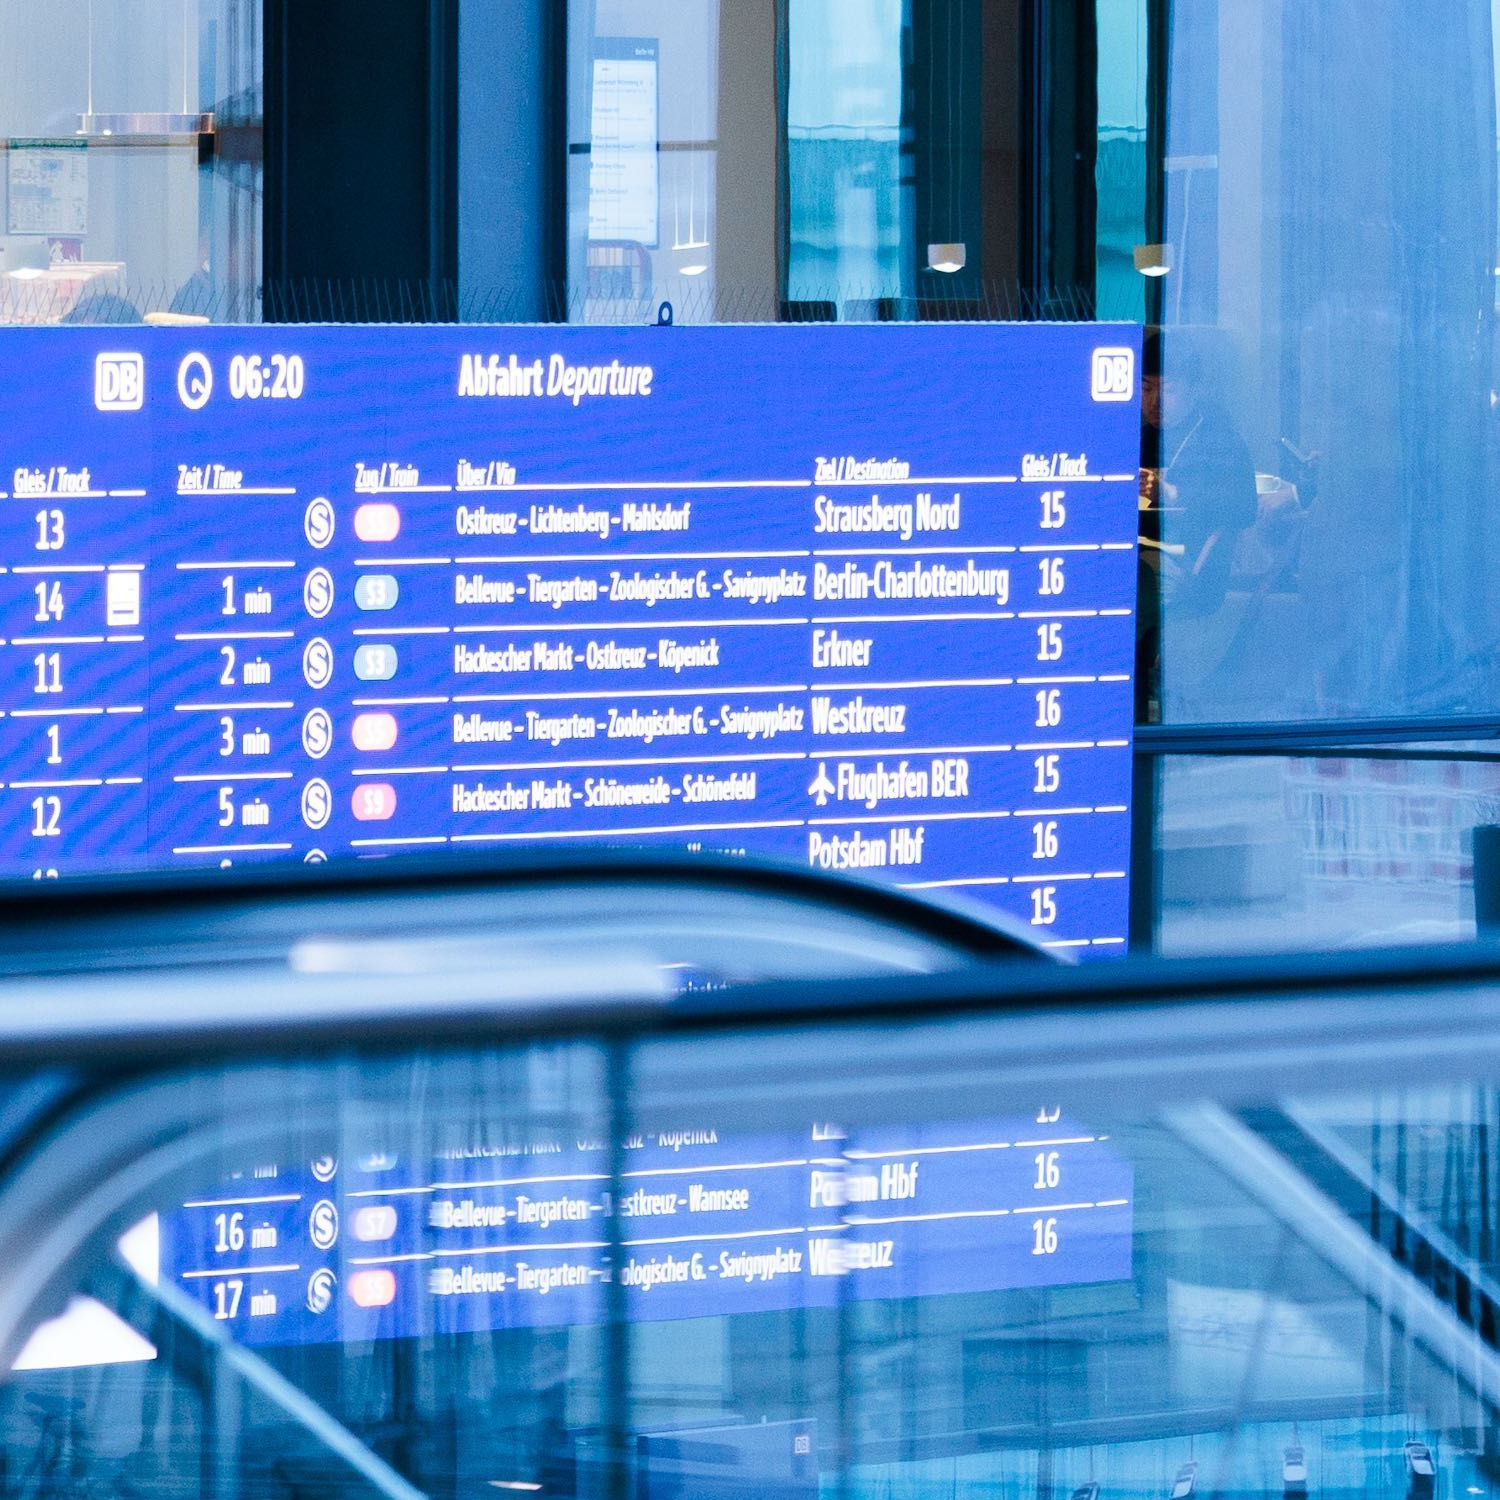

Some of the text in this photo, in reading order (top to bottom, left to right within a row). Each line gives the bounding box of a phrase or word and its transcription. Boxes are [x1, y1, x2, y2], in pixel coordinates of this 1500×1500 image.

[229, 353, 304, 399] 06:20
[457, 353, 654, 407] Abfahrt Departure
[35, 509, 65, 550] 13
[455, 501, 691, 540] Ostkreuz Lichtenberg Mahlsdorf
[814, 492, 961, 541] Strausberg Nord
[1039, 490, 1066, 529] 15
[221, 575, 272, 615] 1 min
[455, 569, 807, 610] Bellevue Tiergarten Zoologischer Savignyplatz
[813, 559, 1010, 606] Berlin-Charlottenburg
[1038, 557, 1065, 595] 16
[34, 580, 65, 622] 14
[454, 637, 720, 674] Hackescher Markt Ostkreuz Köpenick
[812, 629, 873, 668] Erkner
[1036, 622, 1063, 661] 15
[33, 652, 64, 694] 11
[220, 645, 271, 686] 2 min
[811, 695, 906, 735] Westkreuz
[1035, 688, 1061, 727] 16
[47, 724, 63, 764] 1
[219, 715, 271, 757] 3 min
[837, 758, 969, 810] Flughafen BER
[1033, 754, 1060, 793] 15
[31, 795, 61, 837] 12
[218, 786, 270, 827] 5 min
[808, 826, 925, 870] Potsdam Hbf
[1032, 820, 1059, 859] 16
[1030, 886, 1057, 926] 15
[1033, 1151, 1060, 1190] 16
[214, 1212, 245, 1253] 16
[1032, 1217, 1058, 1255] 16
[213, 1279, 244, 1320] 17
